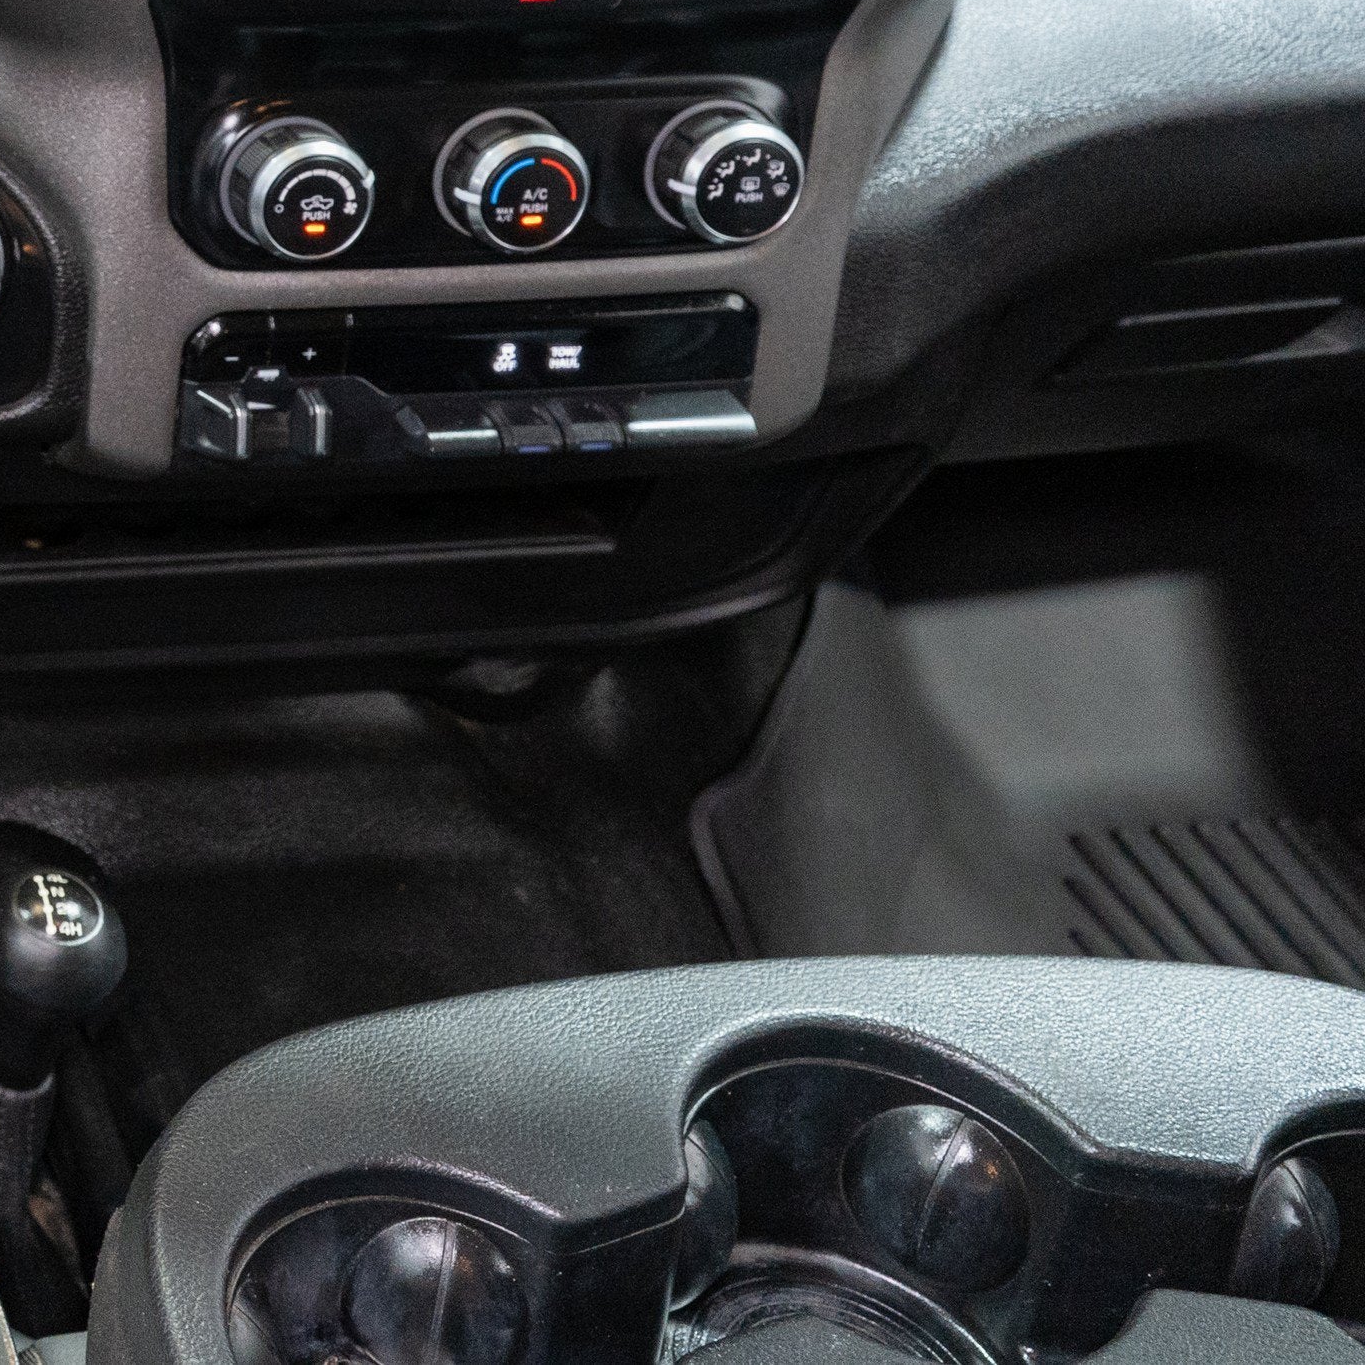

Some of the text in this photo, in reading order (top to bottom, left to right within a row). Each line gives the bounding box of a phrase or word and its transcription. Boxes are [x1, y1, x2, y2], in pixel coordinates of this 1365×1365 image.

[522, 187, 548, 202] A/C
[734, 191, 764, 203] PUSH
[519, 202, 548, 214] PUSH
[302, 210, 330, 222] PUSH
[50, 886, 65, 897] N
[59, 921, 83, 937] 4H
